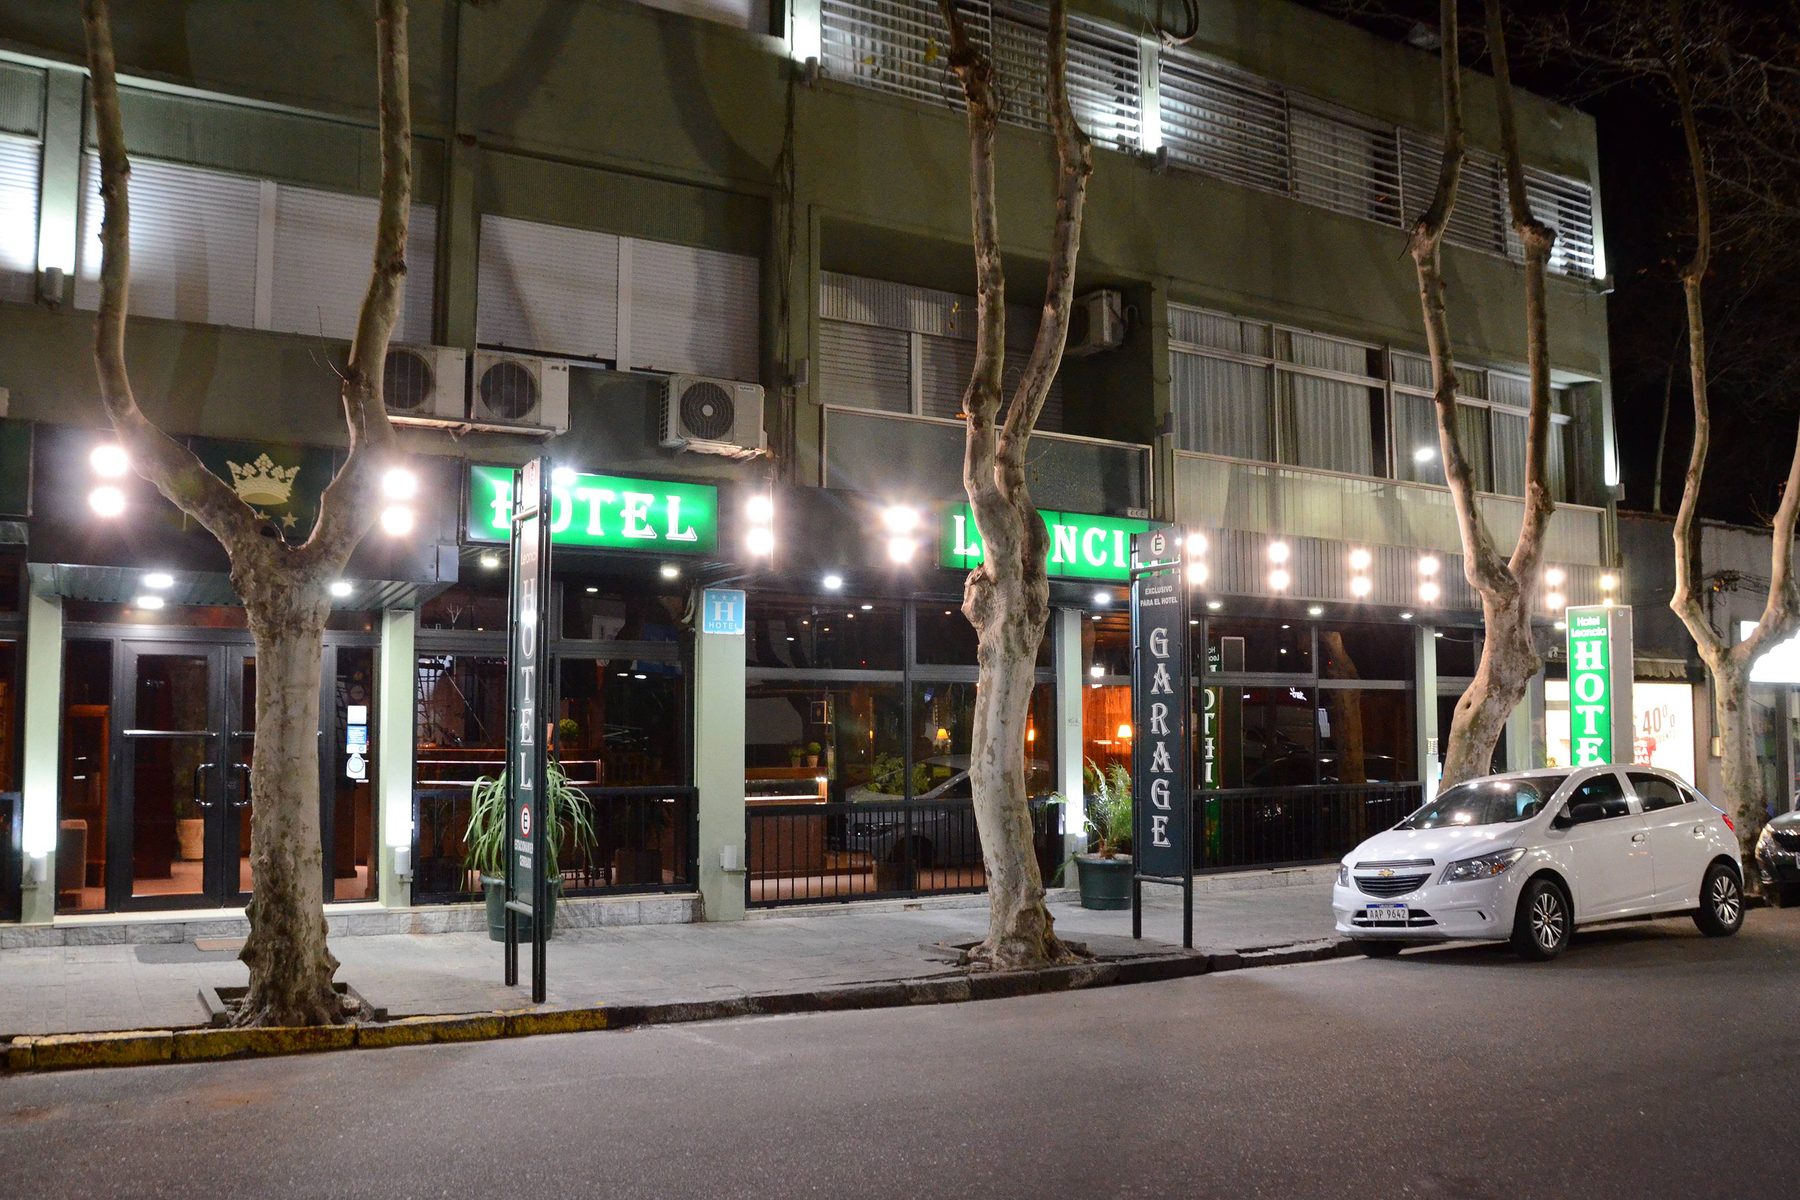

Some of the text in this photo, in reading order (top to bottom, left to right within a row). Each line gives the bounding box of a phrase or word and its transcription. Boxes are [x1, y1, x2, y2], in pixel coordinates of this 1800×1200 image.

[1145, 585, 1173, 595] EXCLUSIVO
[712, 601, 735, 622] H
[1140, 596, 1178, 607] PARA EL HOTEL
[1576, 616, 1600, 627] Hotel
[519, 578, 536, 791] HOTEL
[1574, 640, 1607, 766] HOTE
[1149, 627, 1174, 848] GARAGE
